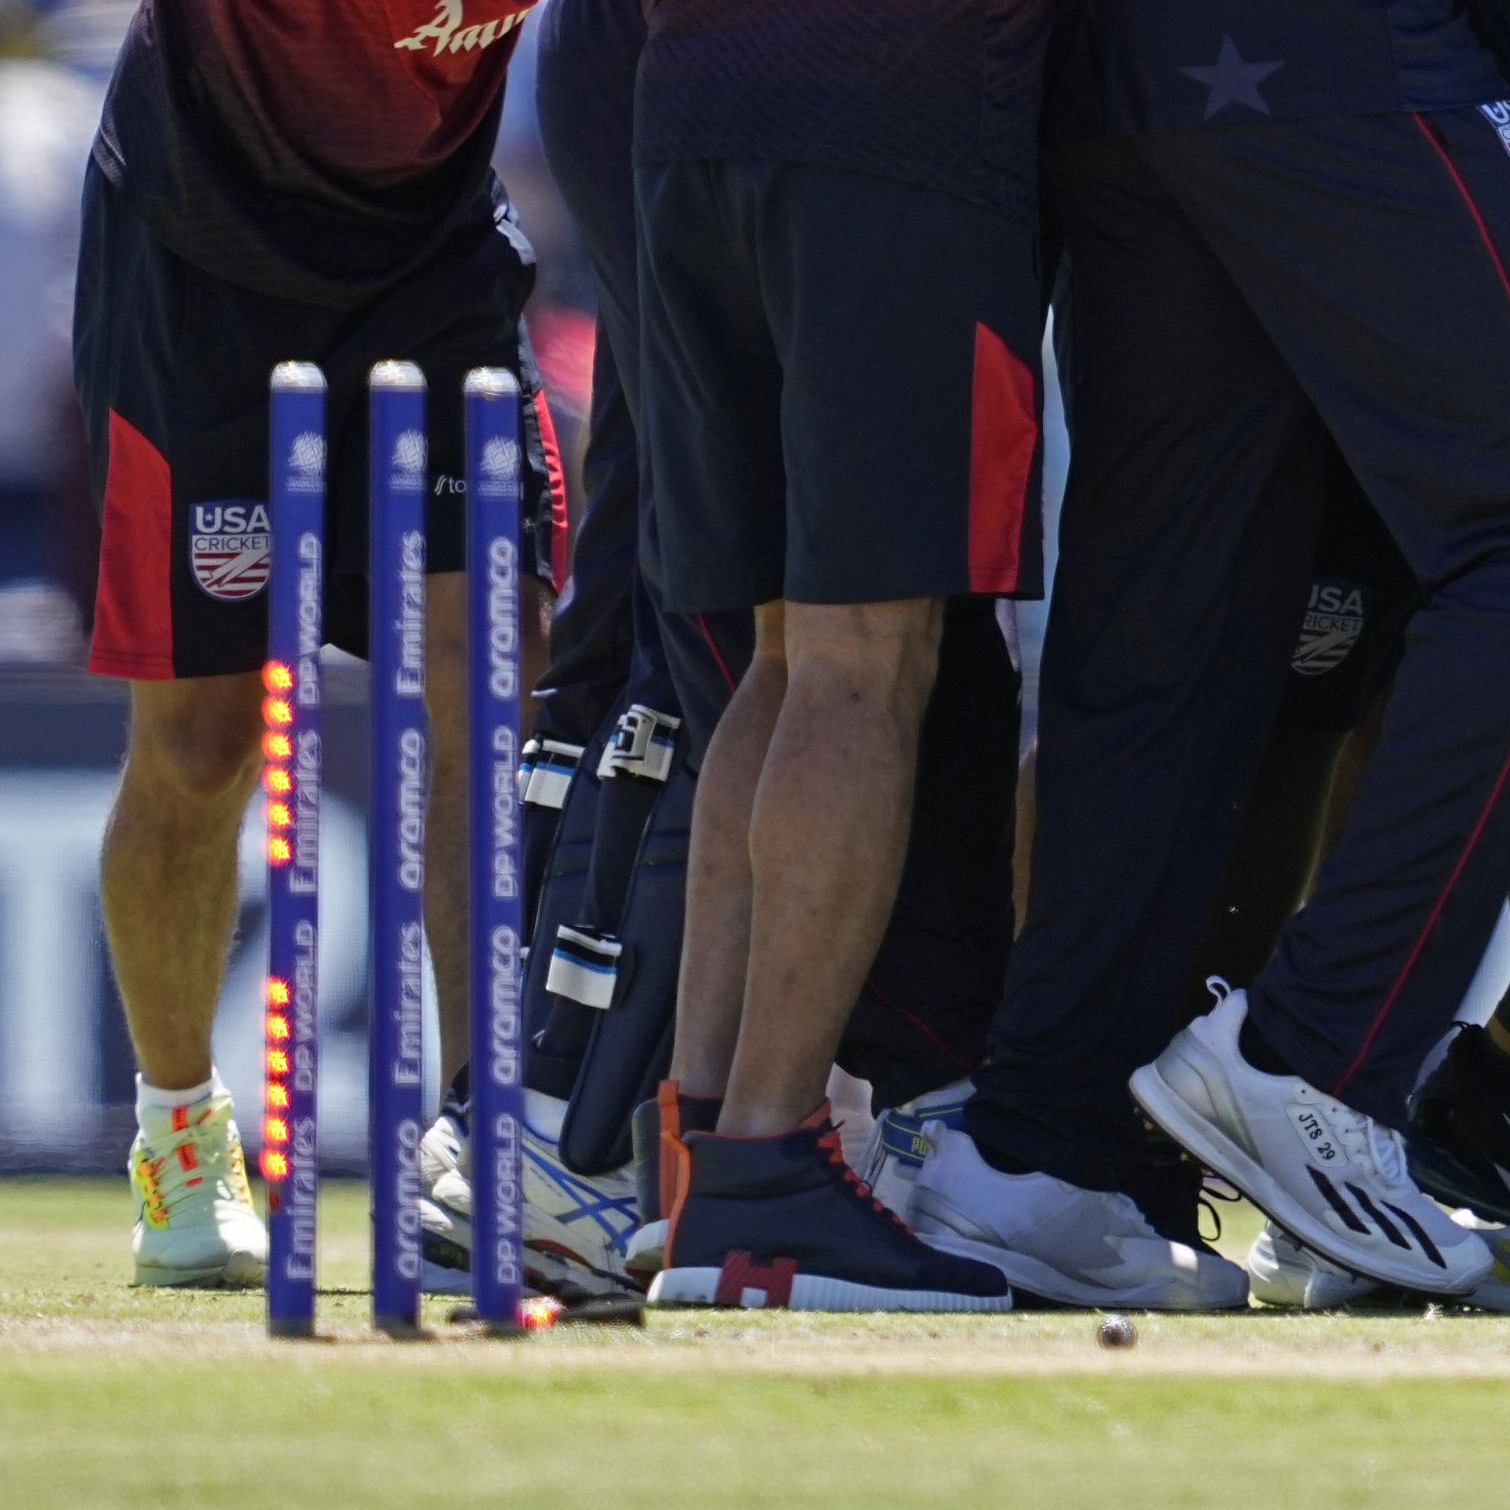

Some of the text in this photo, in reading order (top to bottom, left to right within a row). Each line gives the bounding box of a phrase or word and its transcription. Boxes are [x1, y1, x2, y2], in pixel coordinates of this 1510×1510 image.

[194, 536, 270, 552] CRICKET
[195, 505, 271, 534] USA
[396, 530, 426, 694] Emirates
[489, 536, 519, 699] aramco
[289, 729, 321, 893] Emirates
[399, 727, 425, 889] aramco
[393, 921, 421, 1085] Emirates
[492, 925, 520, 1085] aramco
[286, 1116, 315, 1279] Emirates
[398, 1119, 420, 1279] aramco
[1298, 1113, 1336, 1161] JTS 29
